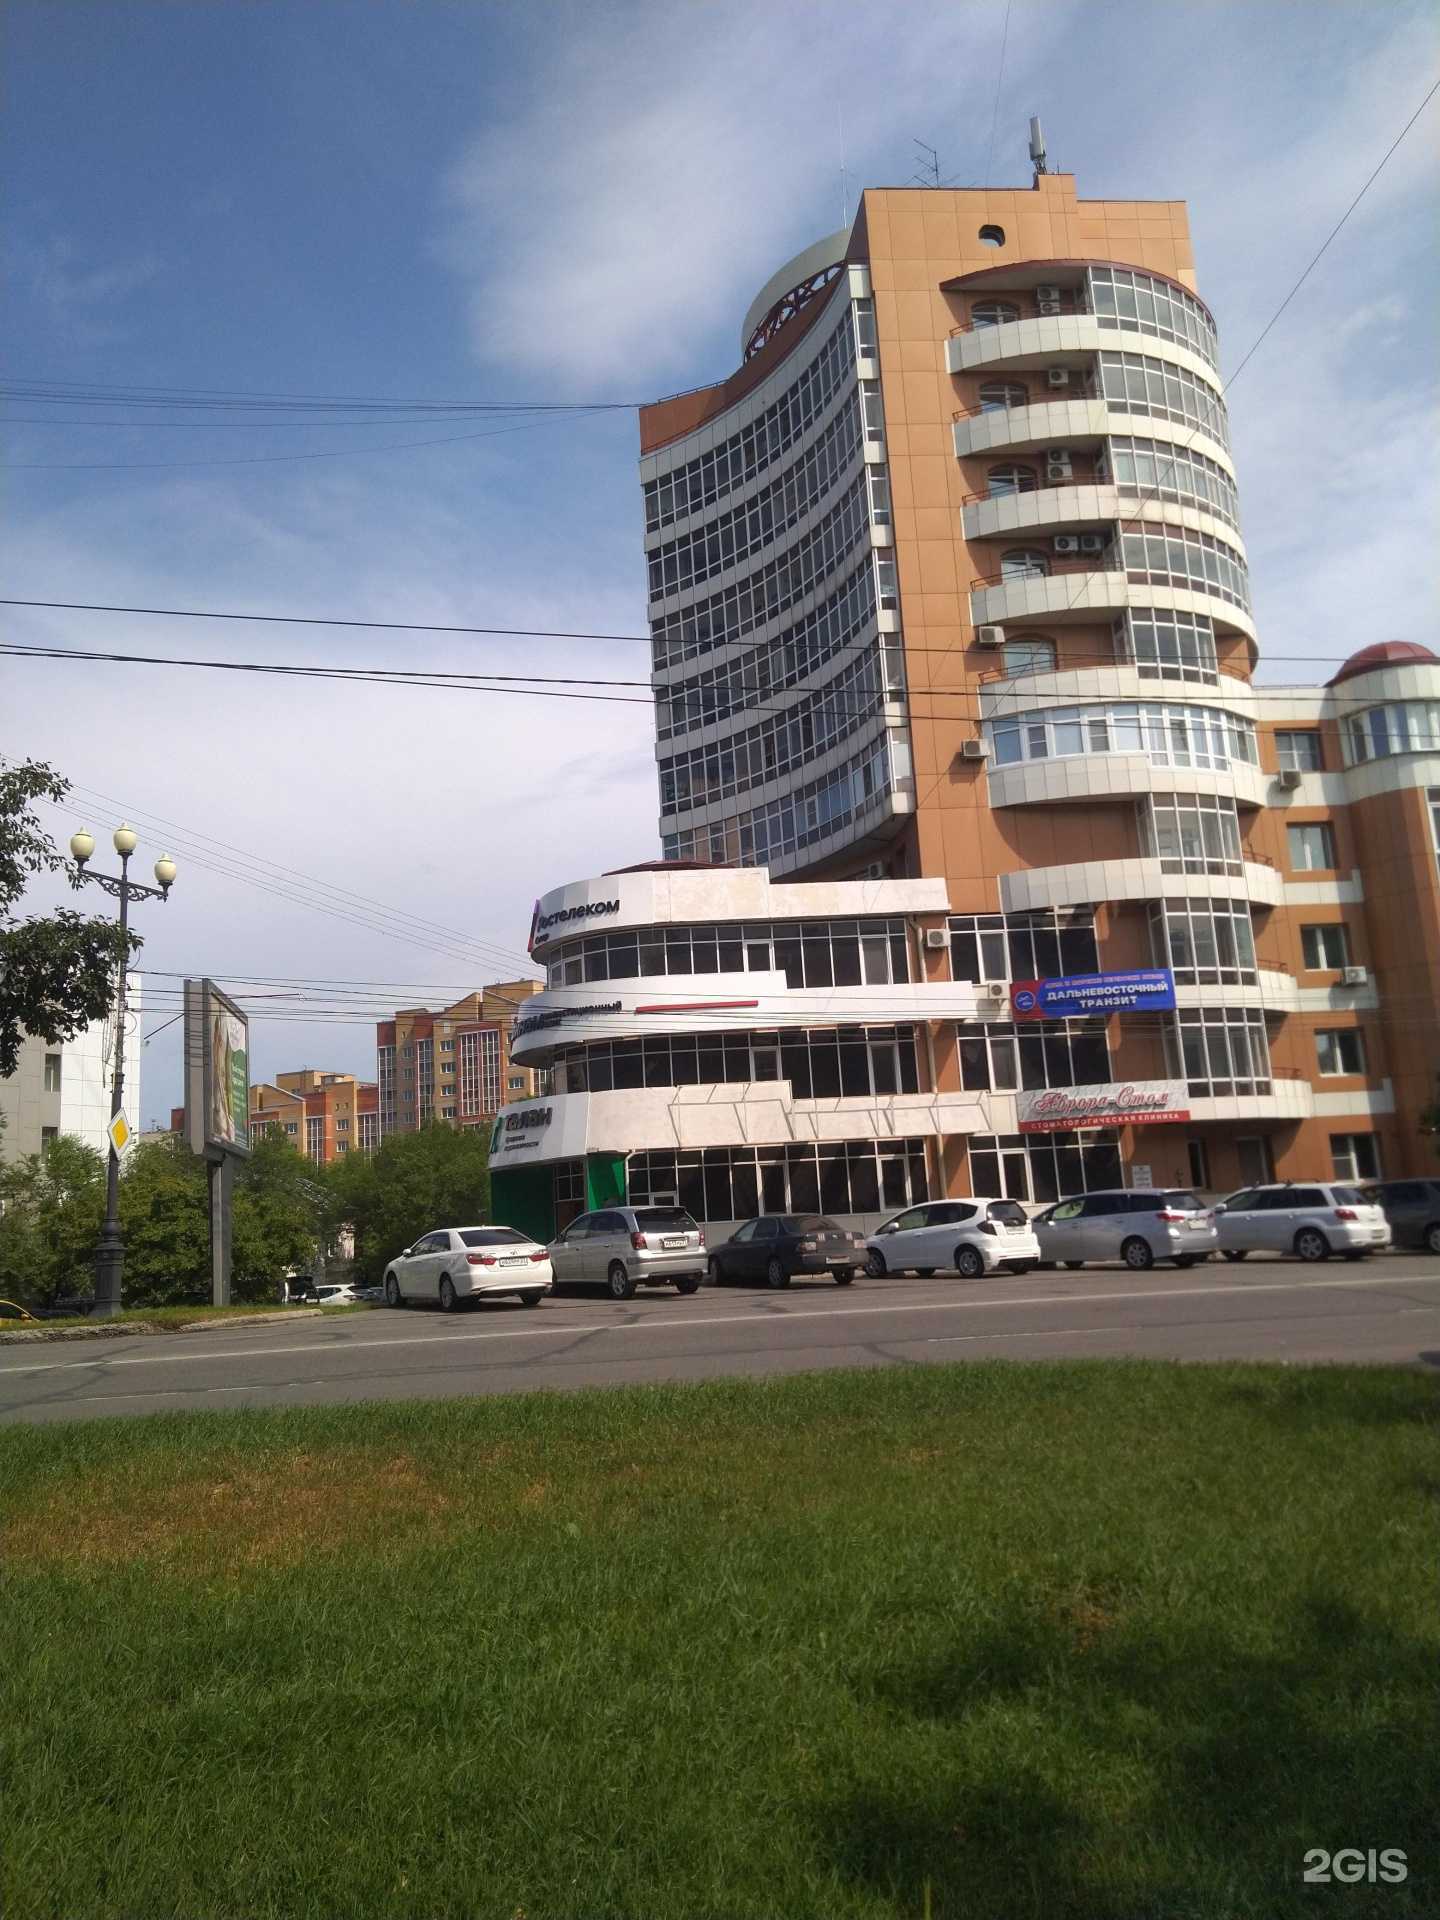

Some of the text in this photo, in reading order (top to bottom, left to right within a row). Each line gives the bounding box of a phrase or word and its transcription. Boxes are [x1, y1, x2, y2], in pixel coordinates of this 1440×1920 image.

[1047, 981, 1168, 1001] ДАЛЬНЕВОСТОЧНЫЙ
[1080, 996, 1137, 1008] ТРАНЗИТ
[1031, 1113, 1180, 1129] СТОМАТОЛОГИЧЕСКАЯ КЛИНИКА
